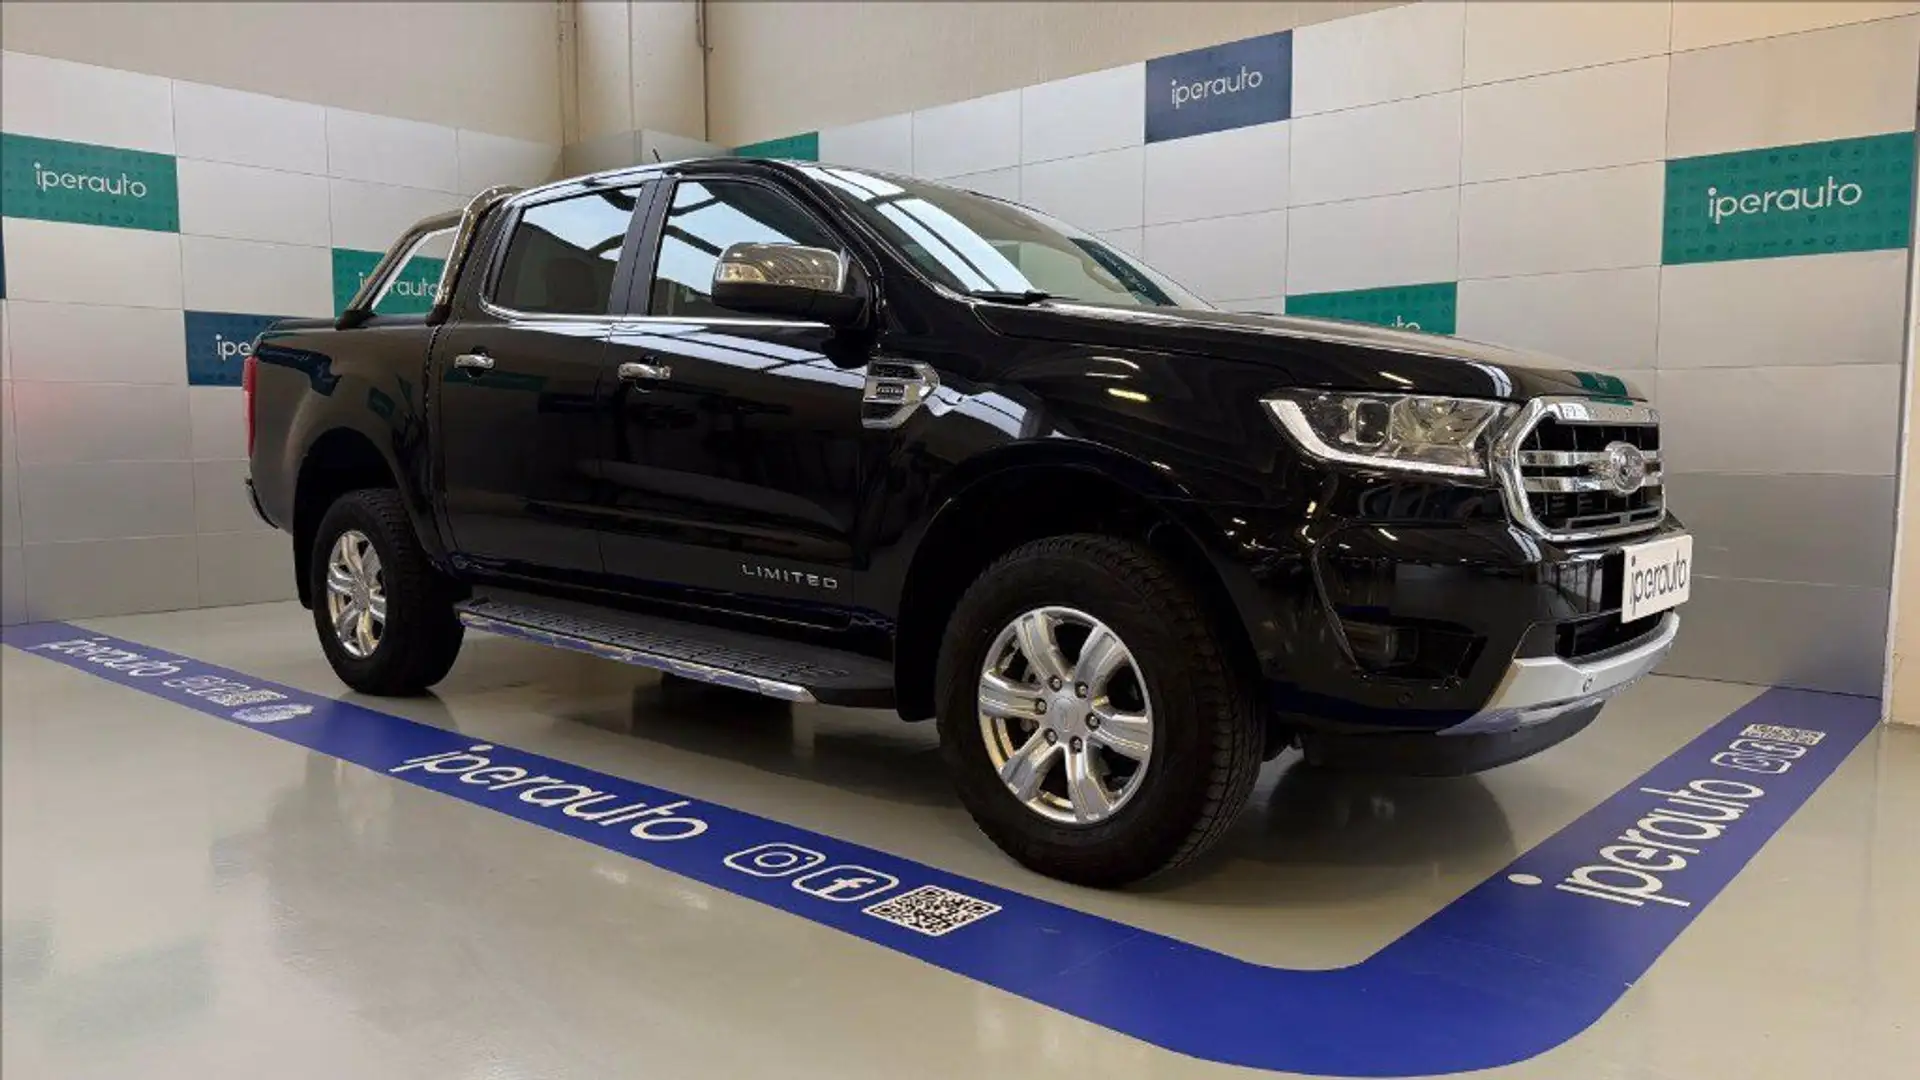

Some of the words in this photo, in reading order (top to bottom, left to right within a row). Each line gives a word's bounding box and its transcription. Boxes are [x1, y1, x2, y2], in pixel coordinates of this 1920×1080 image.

[1171, 65, 1263, 109] iperauto
[33, 161, 147, 198] iperauto
[1707, 175, 1863, 225] iperauto
[358, 271, 438, 297] irauto
[742, 564, 838, 589] LIMITED
[1628, 548, 1687, 617] iperauto
[388, 744, 708, 840] iperauto
[1507, 779, 1765, 907] iperauto
